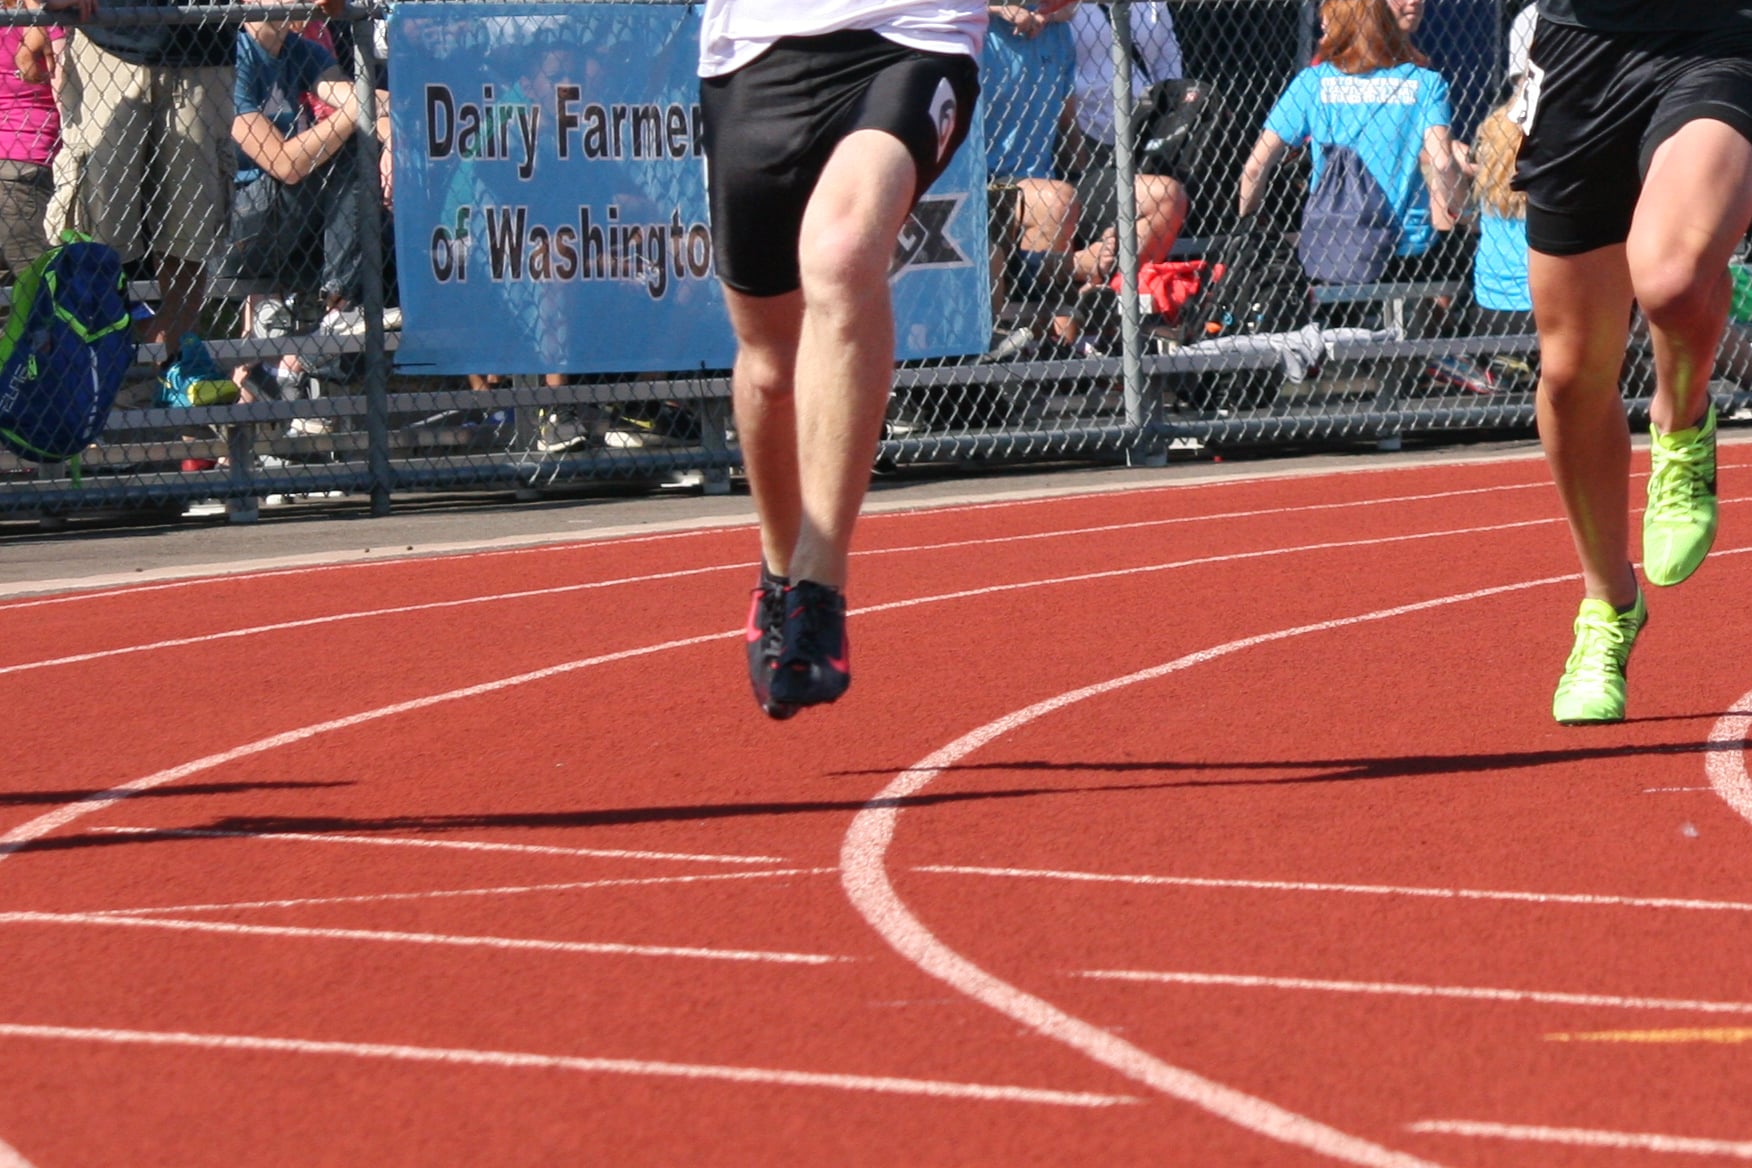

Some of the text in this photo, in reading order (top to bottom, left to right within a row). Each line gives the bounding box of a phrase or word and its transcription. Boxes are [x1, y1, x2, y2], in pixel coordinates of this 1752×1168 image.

[424, 83, 541, 182] Dairy
[431, 204, 722, 300] of Washingto
